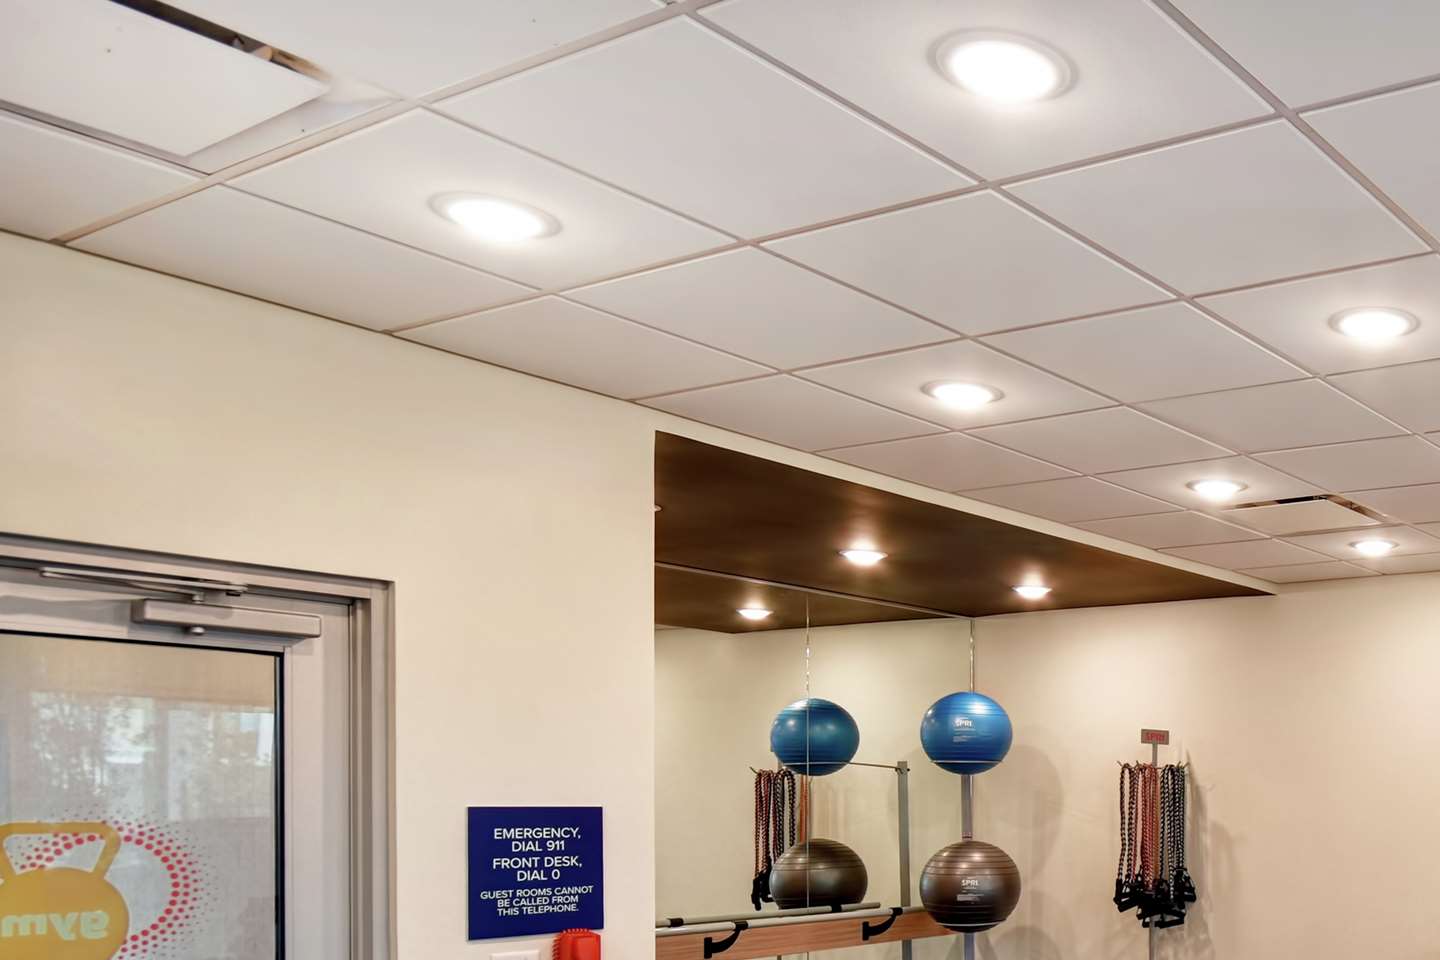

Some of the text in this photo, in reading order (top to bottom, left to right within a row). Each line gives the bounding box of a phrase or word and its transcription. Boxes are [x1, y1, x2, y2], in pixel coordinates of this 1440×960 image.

[494, 827, 581, 839] EMERGENCY,
[512, 840, 565, 852] DIAL 911
[493, 856, 582, 869] FRONT DESK,
[517, 869, 560, 881] DIAL 0
[961, 879, 978, 887] SPRI
[480, 886, 593, 899] GUEST ROOMS CANNOT
[498, 895, 578, 907] BE CALLED FROM
[497, 904, 579, 916] THIS TELEPHONE.
